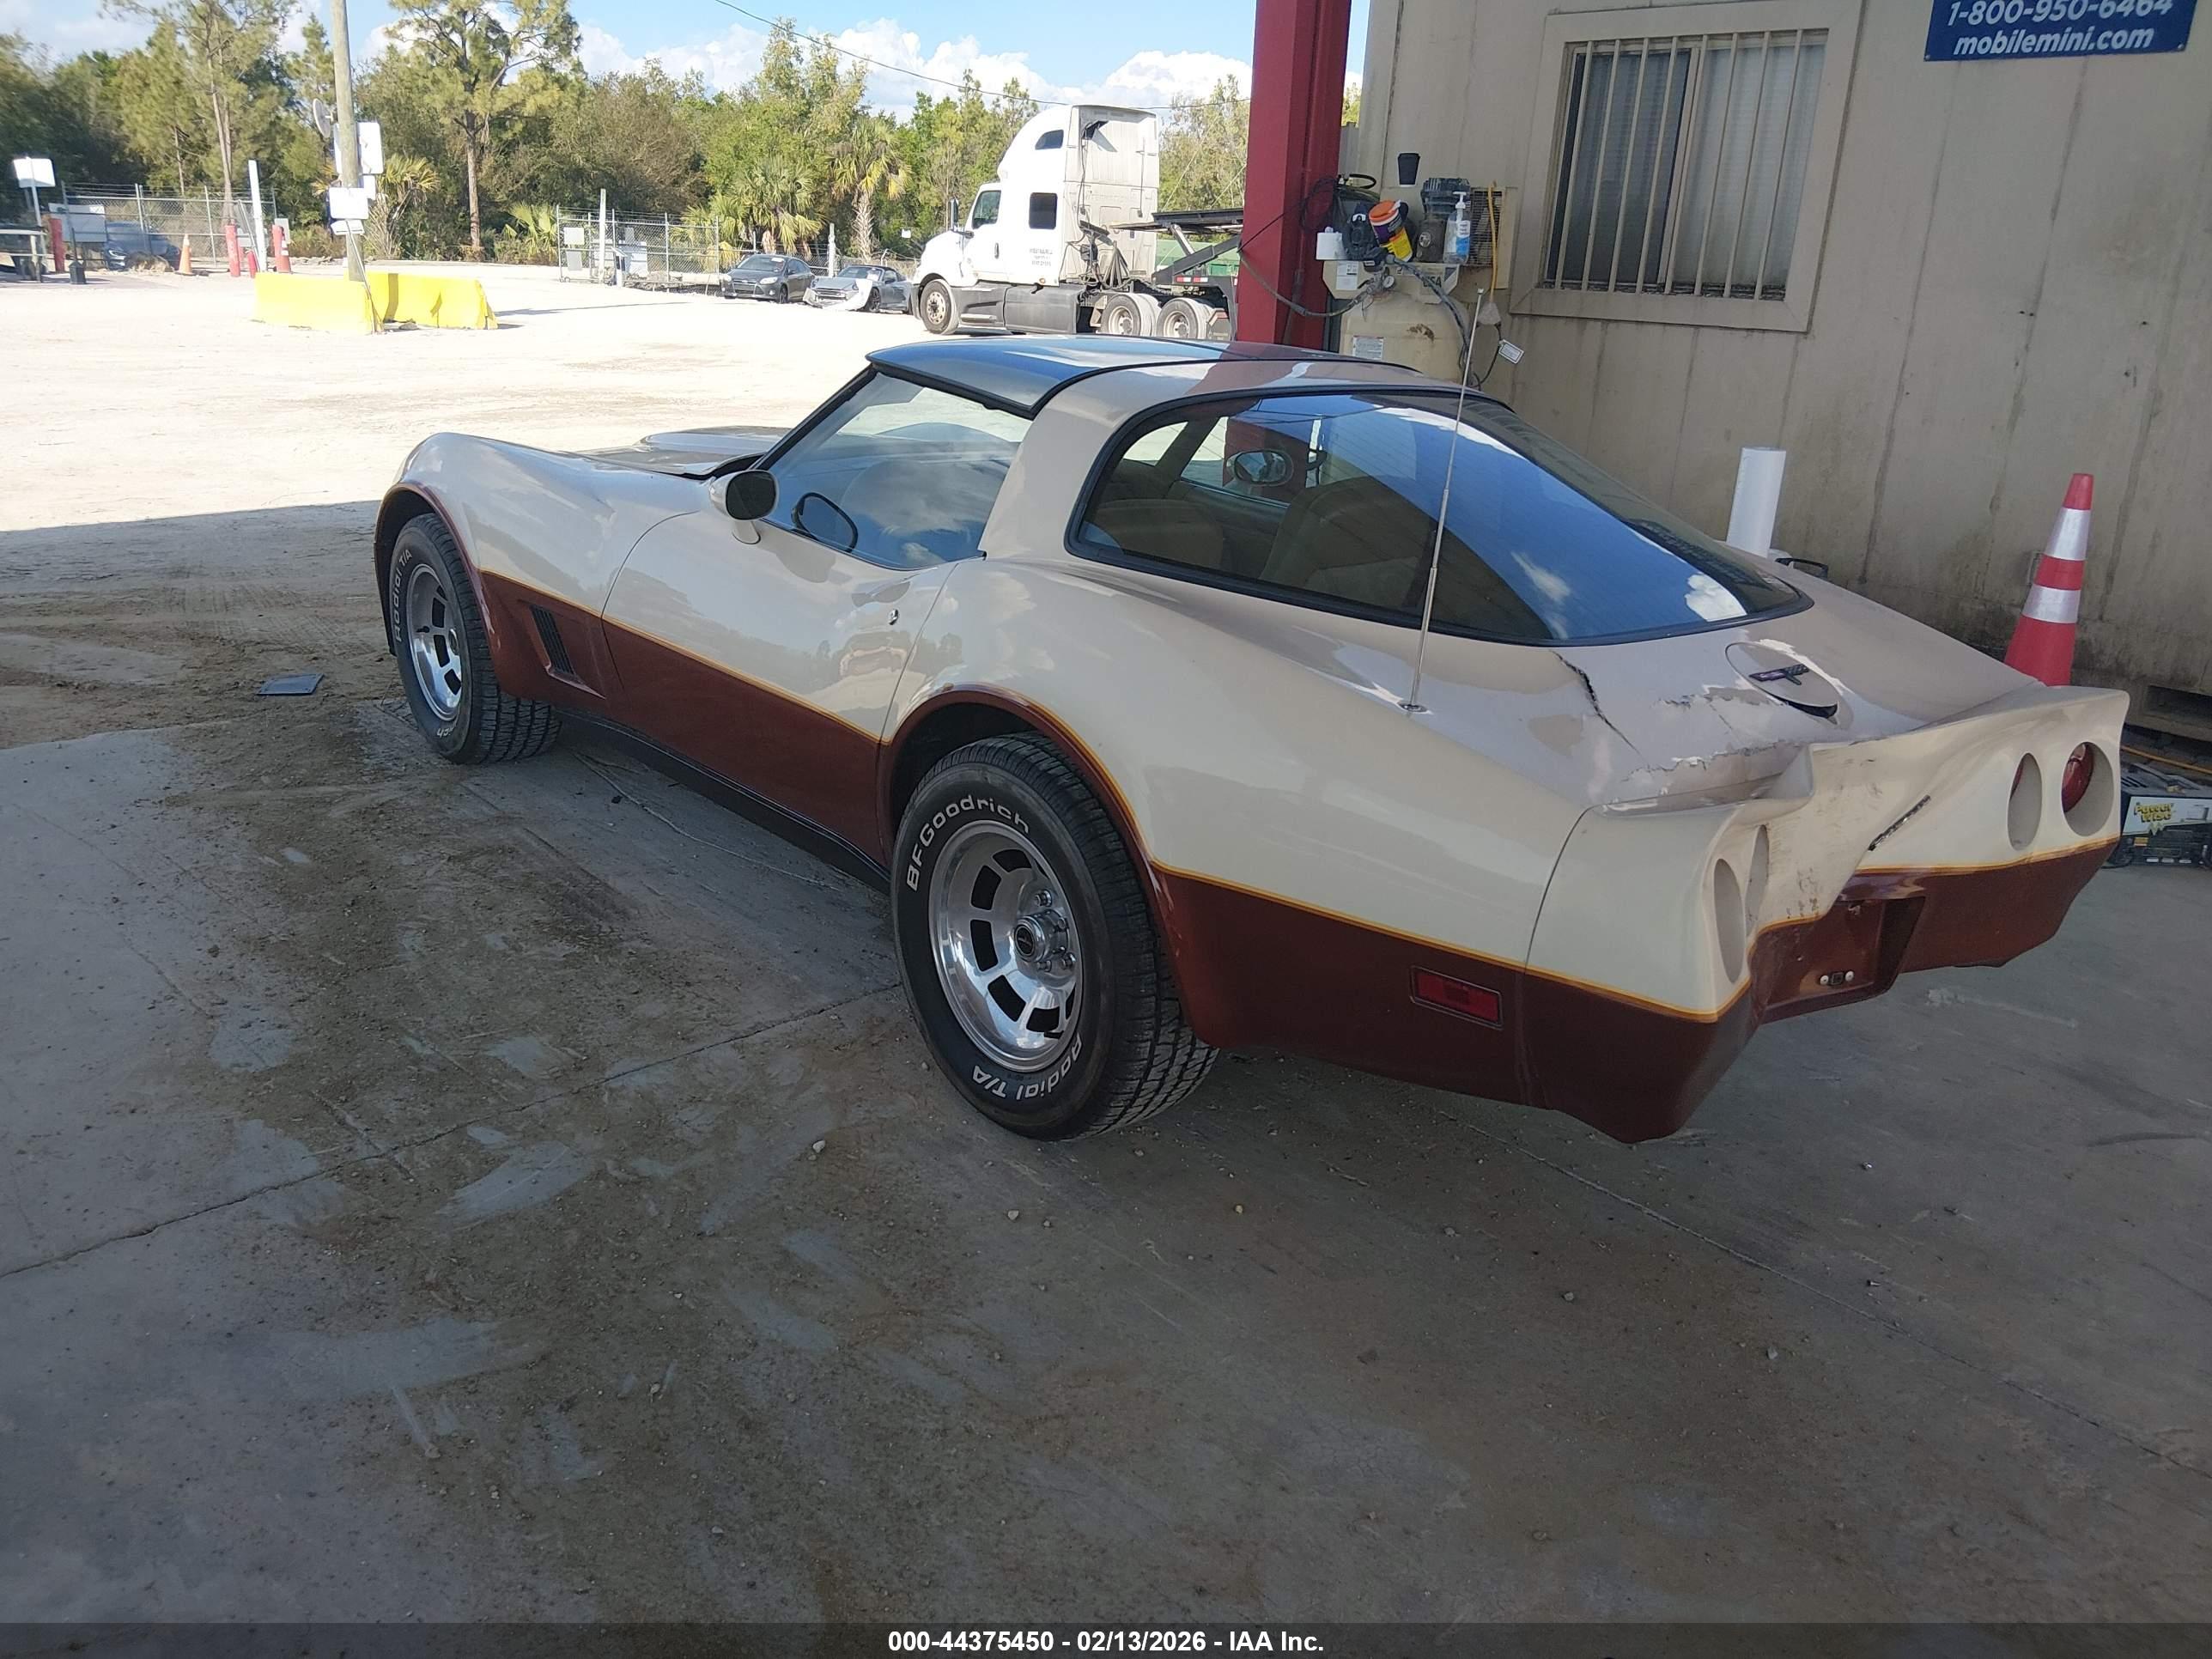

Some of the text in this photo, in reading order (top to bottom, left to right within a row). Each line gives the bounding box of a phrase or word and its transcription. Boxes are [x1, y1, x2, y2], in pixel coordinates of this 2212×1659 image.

[1948, 0, 2173, 27] 1-800-950-6464
[1954, 26, 2155, 55] mobilemini.com
[906, 794, 1030, 892] BFGoodrich
[972, 1033, 1084, 1100] Radial T/A
